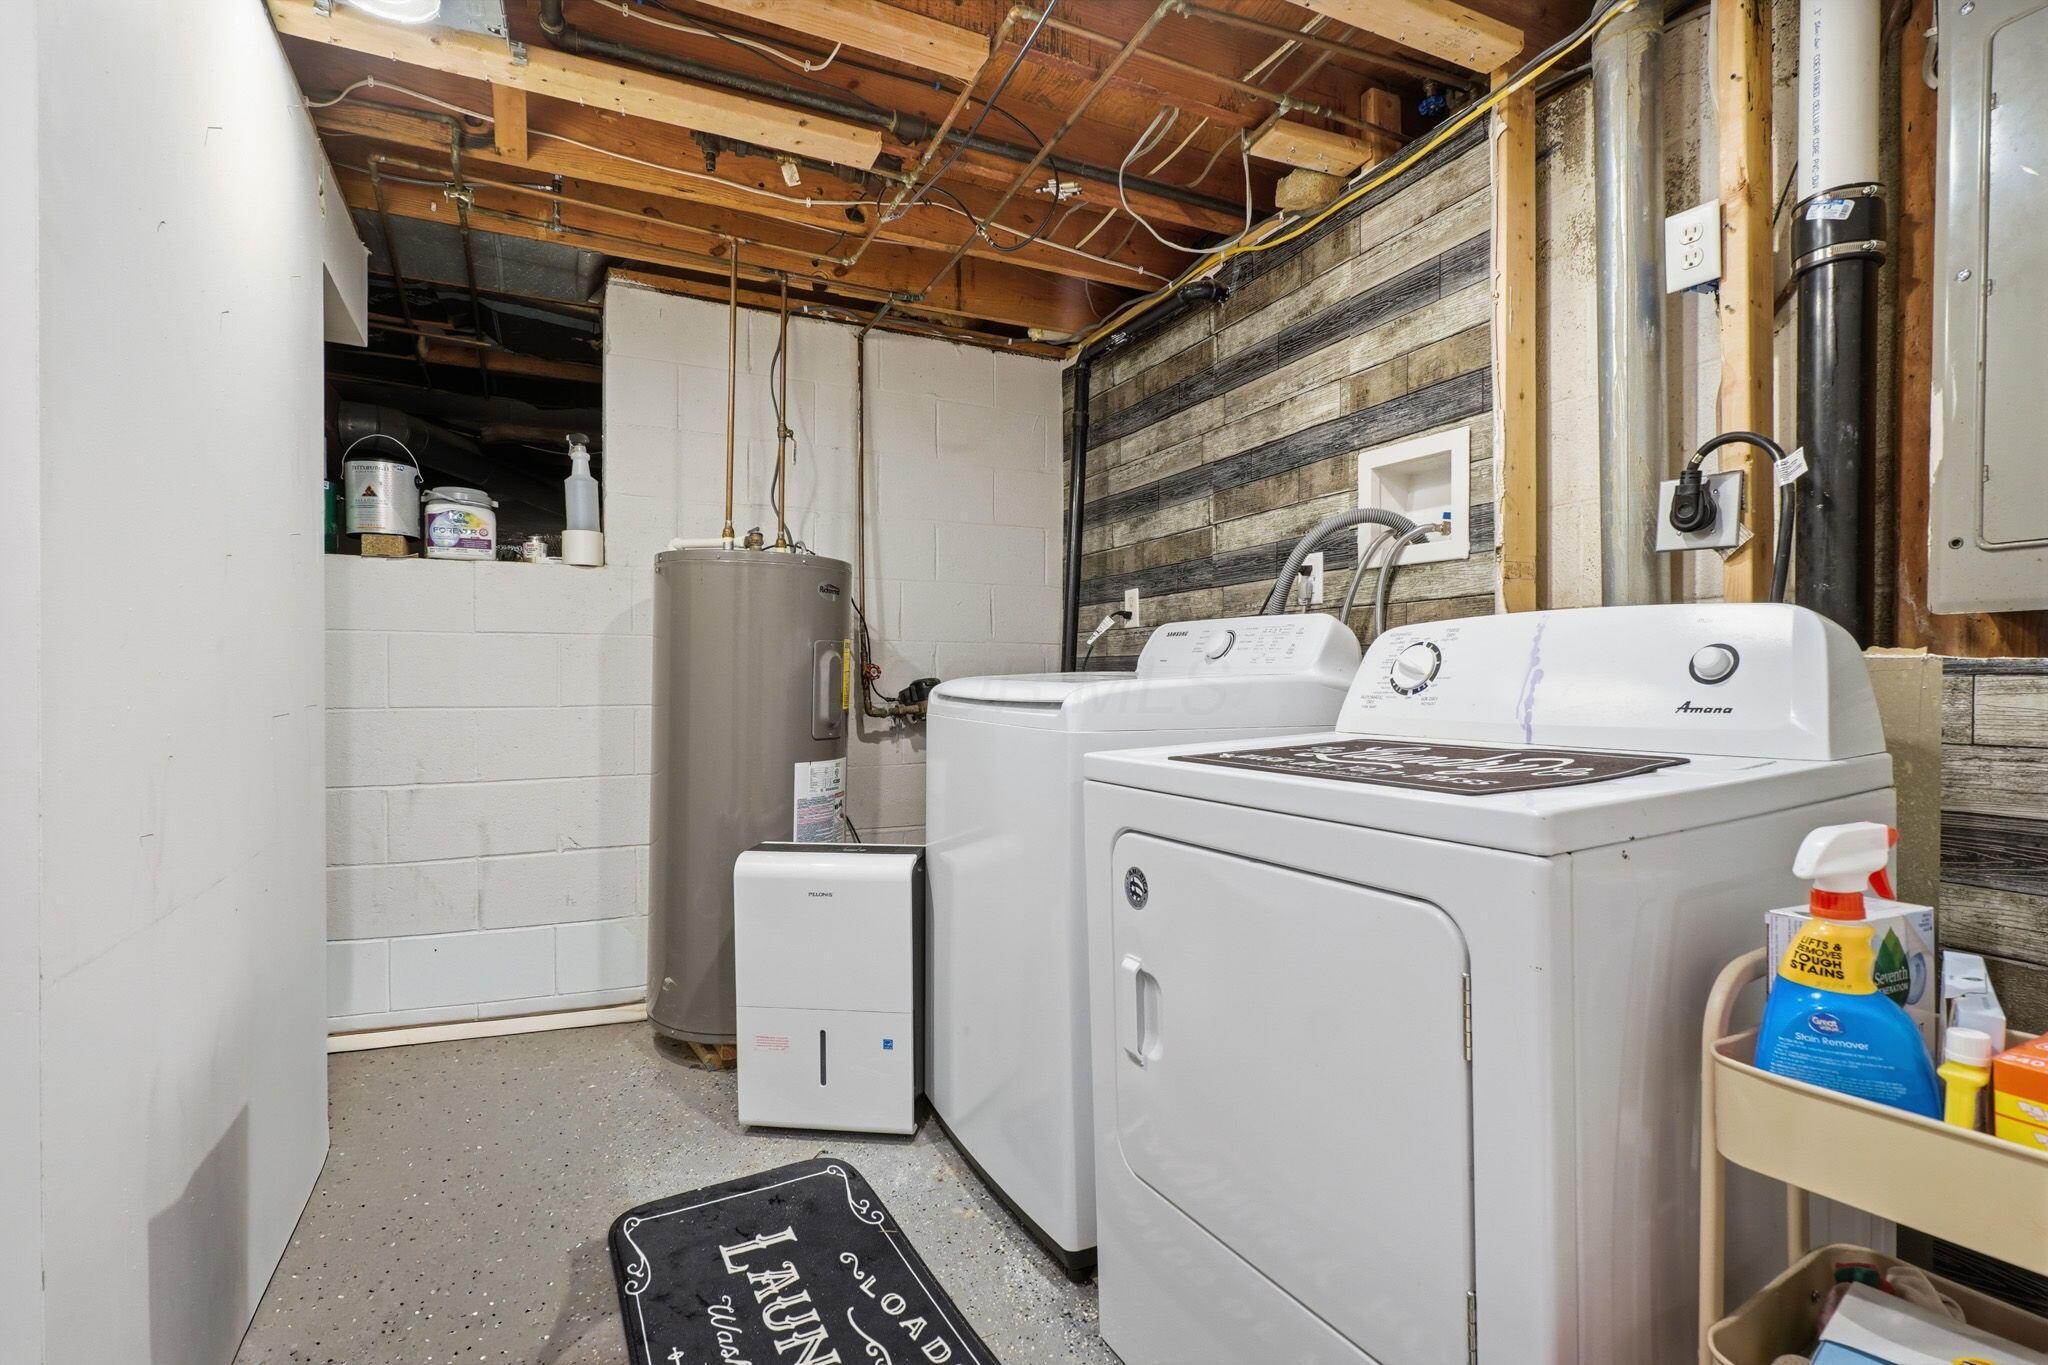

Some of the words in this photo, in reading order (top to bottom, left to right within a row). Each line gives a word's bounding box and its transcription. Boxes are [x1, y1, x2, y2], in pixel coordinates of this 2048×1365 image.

[433, 527, 477, 536] FOREVR
[1674, 700, 1734, 714] Amana
[1797, 943, 1843, 960] REMOVES
[1800, 936, 1829, 950] LIFTS
[1832, 944, 1843, 952] &
[1793, 950, 1842, 970] TOUGH
[1790, 959, 1844, 980] STAINS
[1874, 966, 1908, 986] Seventh
[1877, 982, 1909, 994] ENERATION
[1795, 1032, 1820, 1044] Stain
[1821, 1037, 1869, 1051] Remover
[860, 1274, 962, 1365] LOAD
